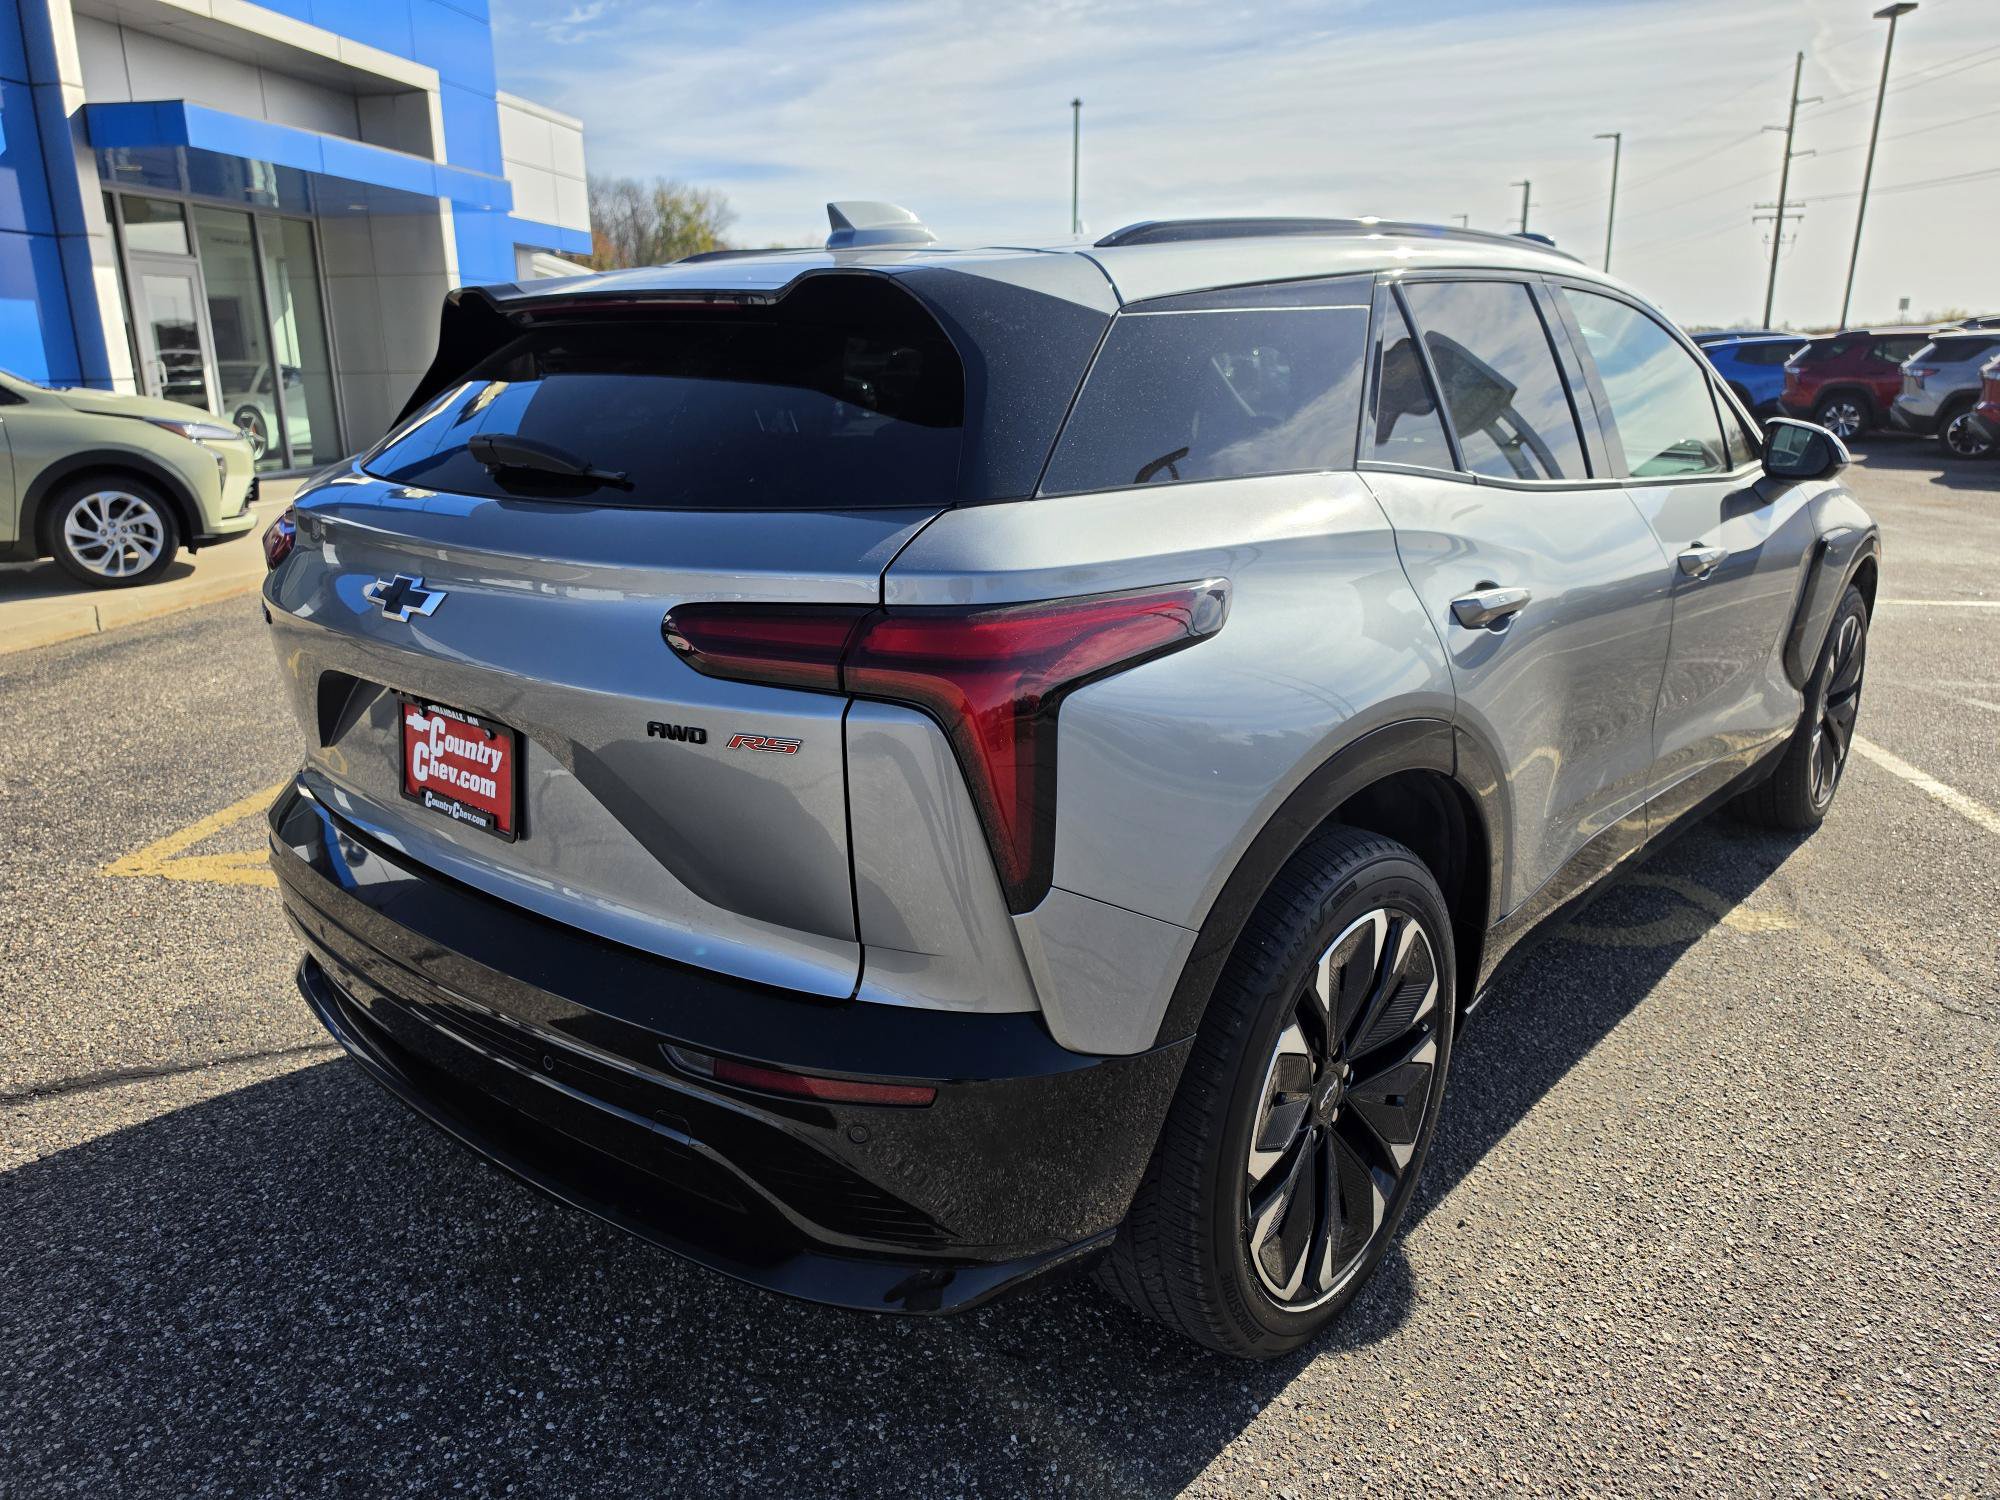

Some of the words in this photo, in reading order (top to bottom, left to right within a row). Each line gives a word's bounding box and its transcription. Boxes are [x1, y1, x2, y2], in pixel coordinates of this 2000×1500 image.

[430, 717, 503, 773] Country
[646, 721, 707, 744] AWD
[726, 733, 803, 755] RS
[412, 742, 496, 799] Chev.com
[425, 791, 487, 827] CountryChev.com
[1220, 1272, 1265, 1344] BRIDGESTONE
